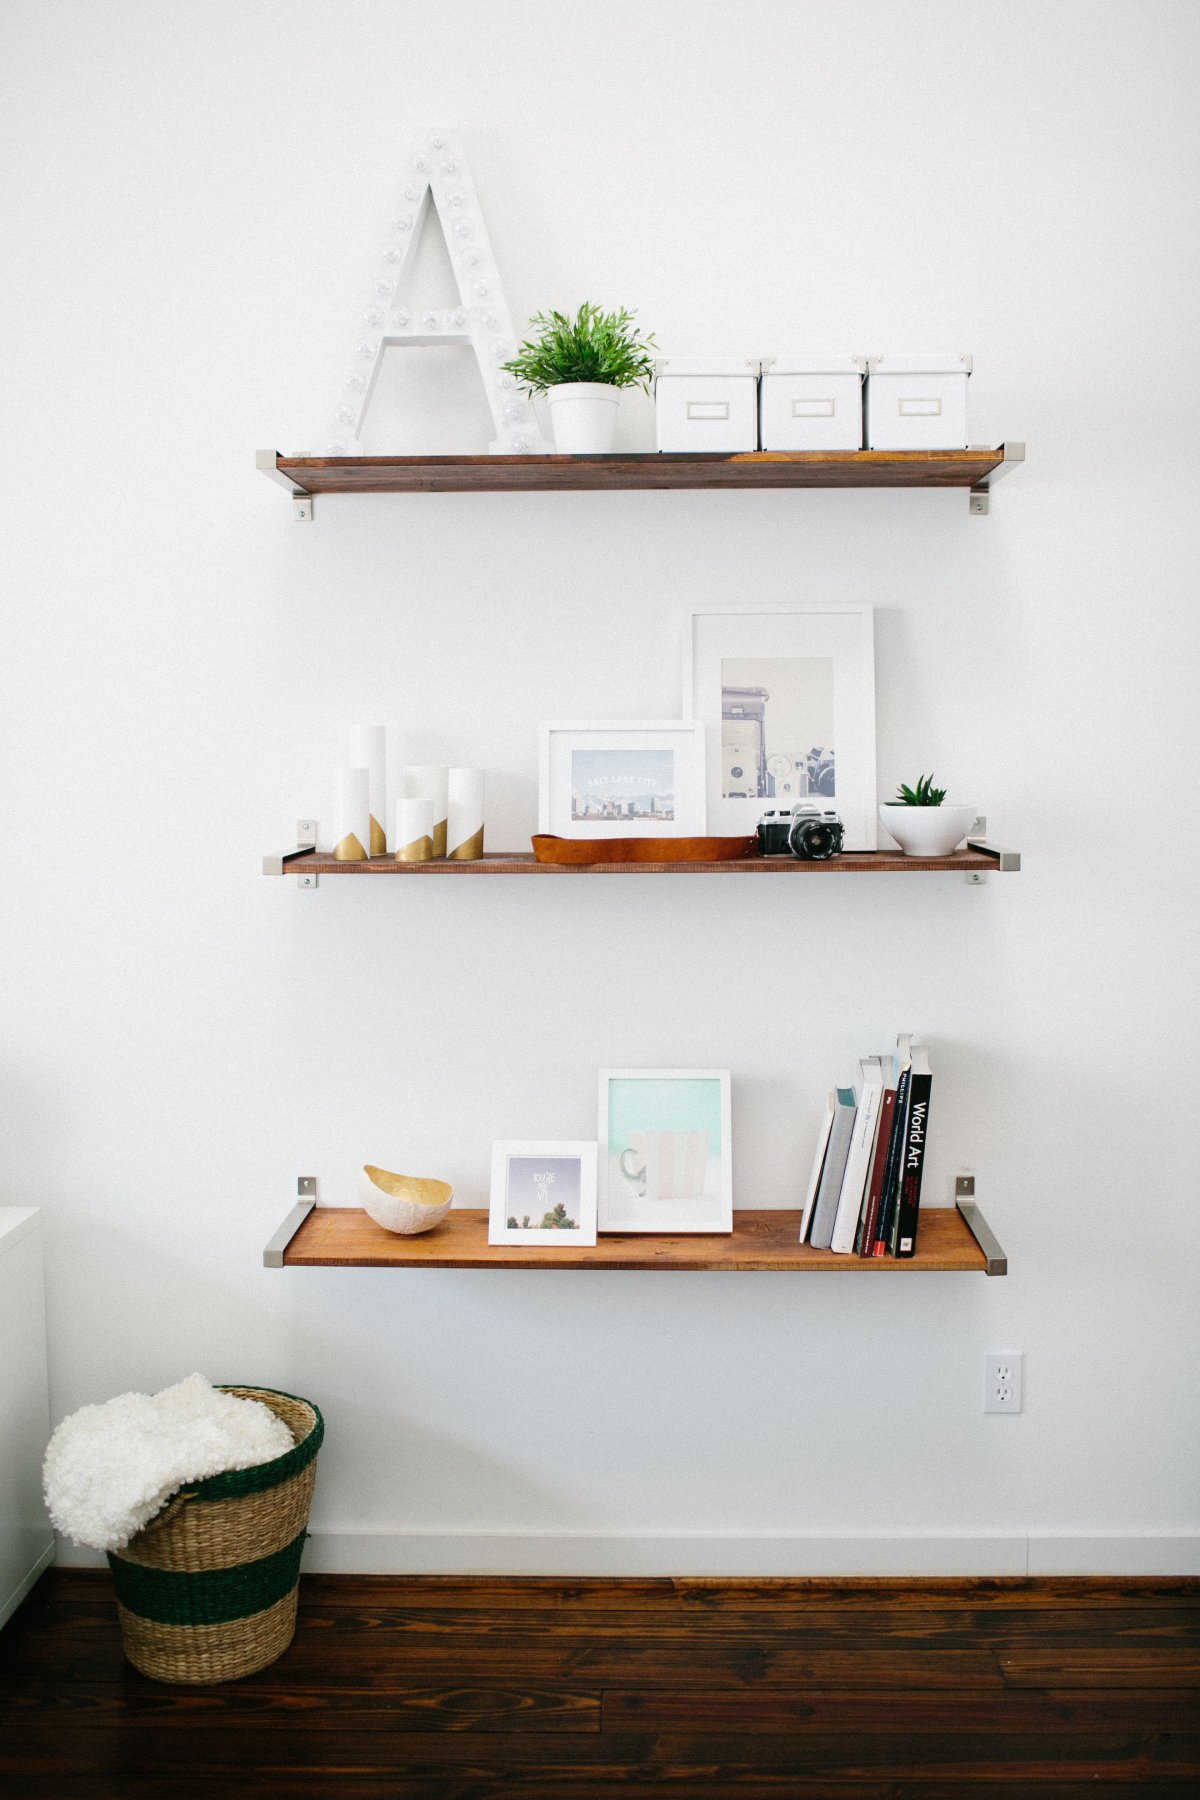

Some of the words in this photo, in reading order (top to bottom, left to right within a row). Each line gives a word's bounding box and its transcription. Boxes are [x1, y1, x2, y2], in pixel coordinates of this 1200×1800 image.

[331, 129, 541, 455] A
[612, 775, 636, 785] LAKE
[637, 776, 659, 788] CITY
[898, 1073, 907, 1104] PHILLIPS
[909, 1102, 927, 1143] World
[907, 1146, 922, 1168] Art
